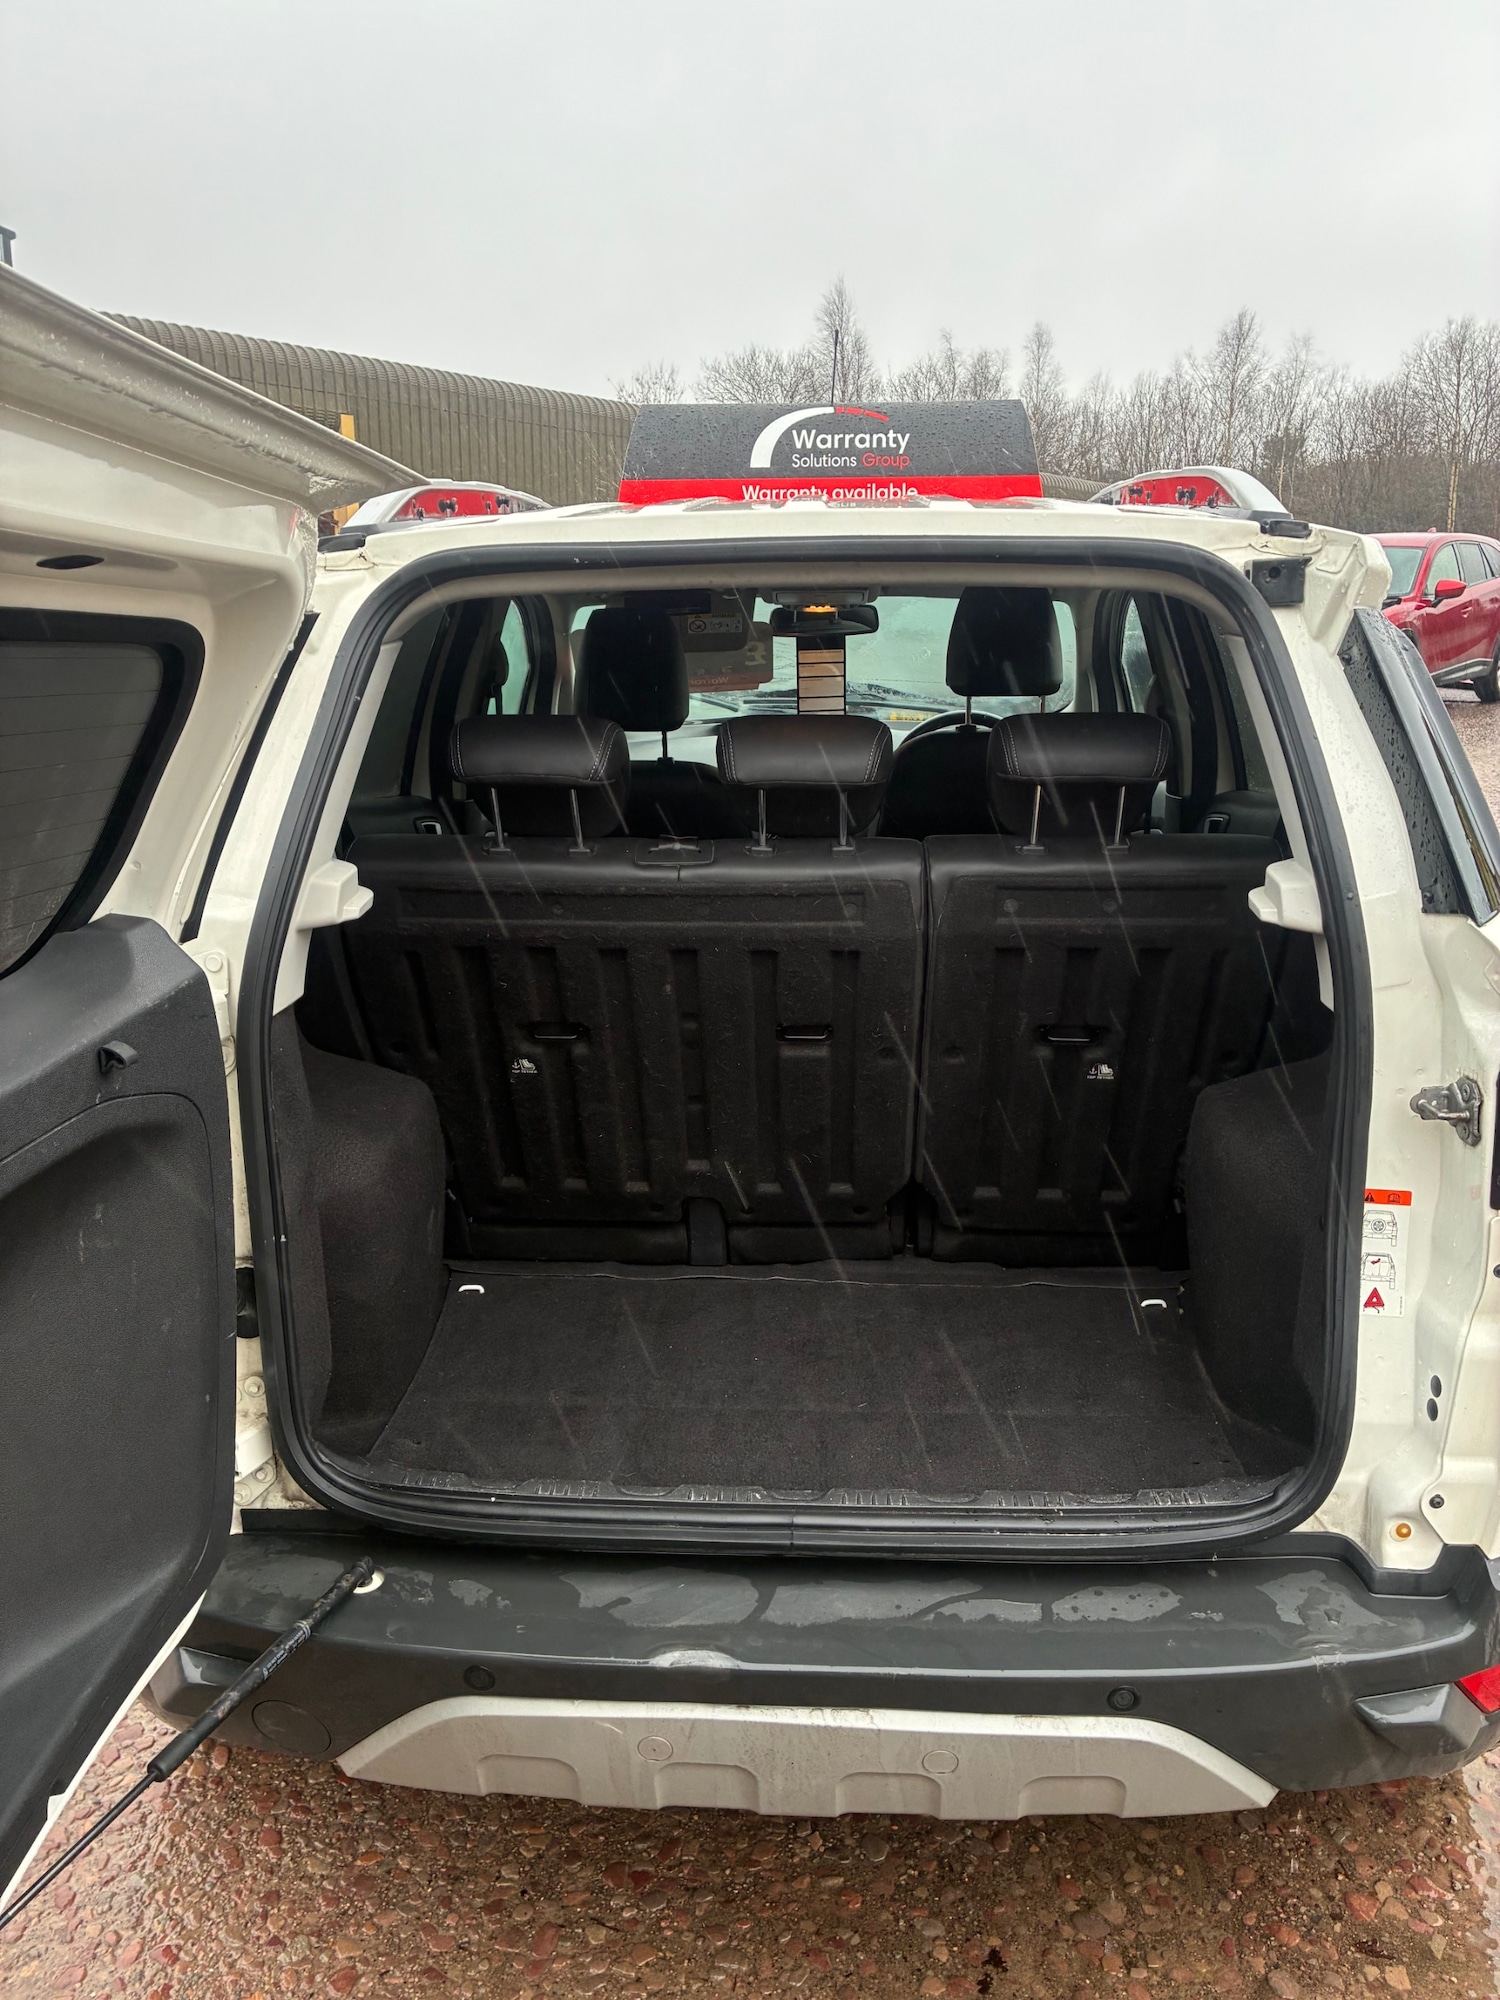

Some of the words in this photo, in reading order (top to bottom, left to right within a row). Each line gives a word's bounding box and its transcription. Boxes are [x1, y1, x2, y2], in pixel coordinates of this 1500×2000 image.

[792, 429, 910, 454] Warranty
[792, 453, 857, 468] Solutions
[861, 452, 910, 470] Group
[832, 482, 918, 500] available
